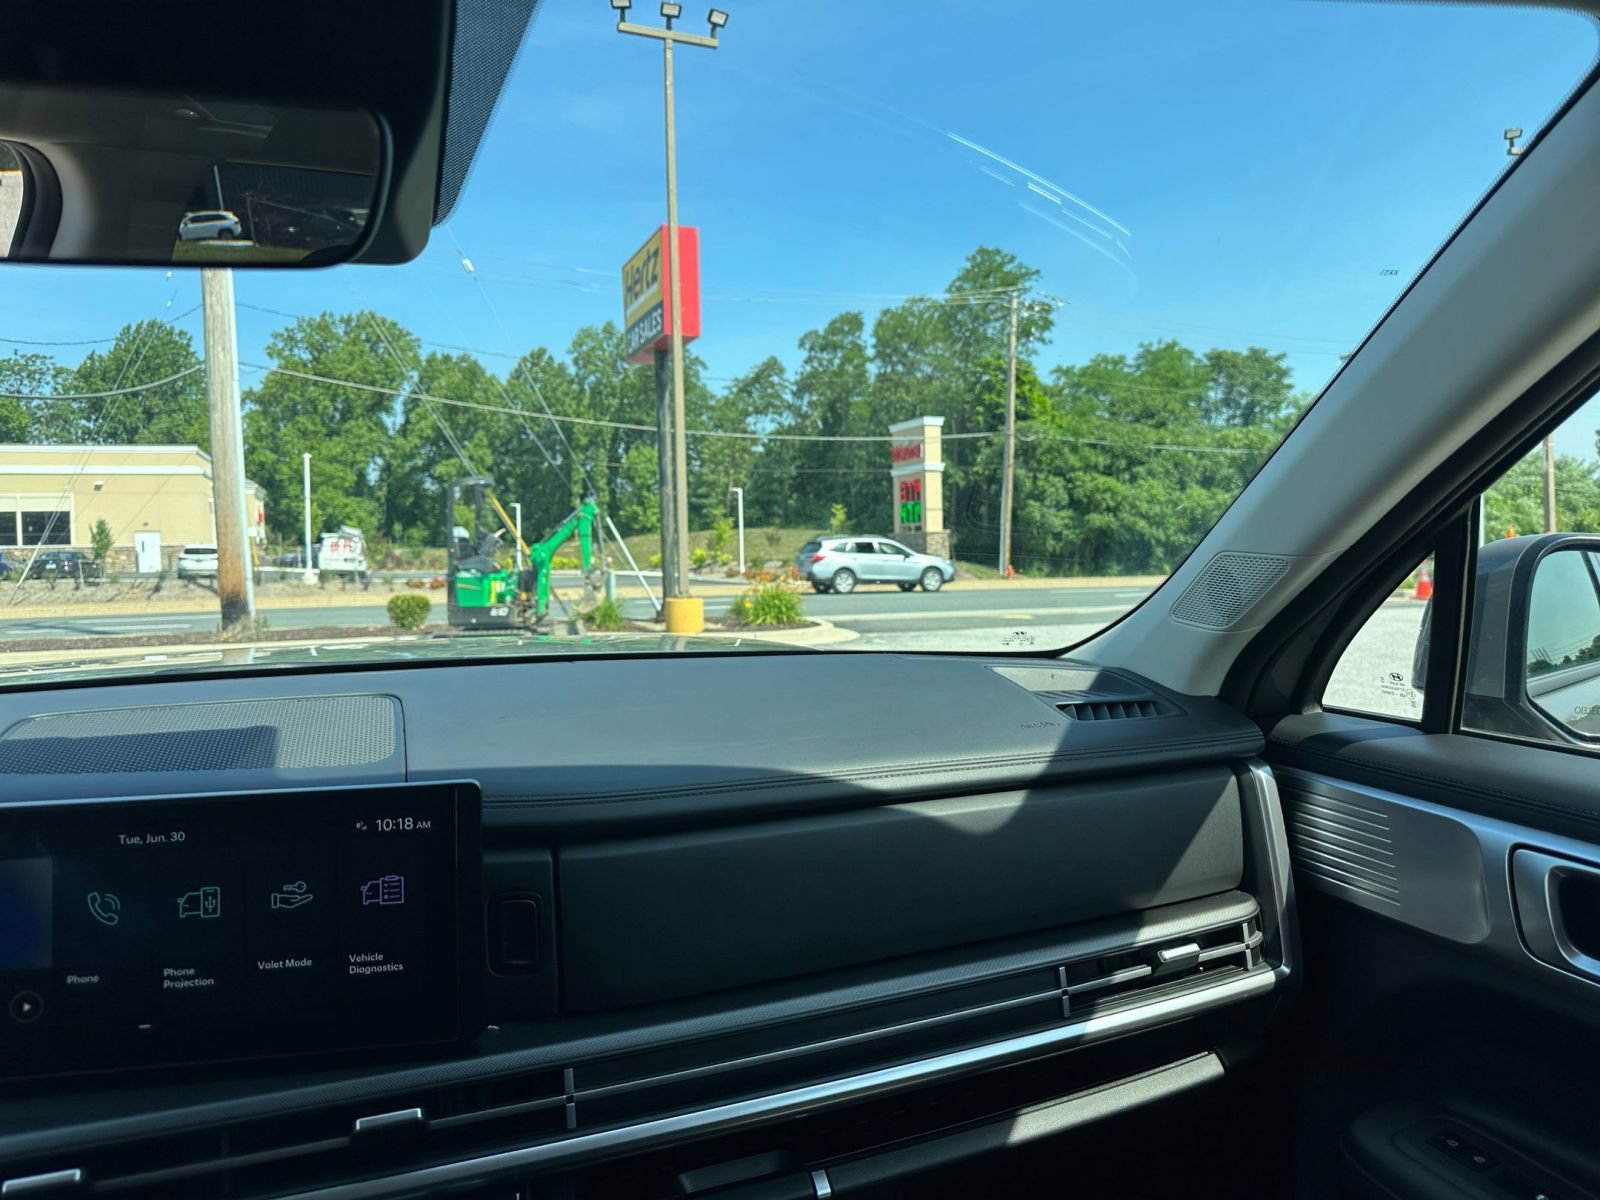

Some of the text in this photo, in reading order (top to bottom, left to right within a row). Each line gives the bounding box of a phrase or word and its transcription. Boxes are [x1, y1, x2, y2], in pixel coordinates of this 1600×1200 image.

[626, 248, 660, 304] Hertz
[640, 308, 662, 342] SALES
[375, 817, 431, 832] 10:18 AM
[118, 831, 186, 846] Tue, Jun. 30
[257, 957, 312, 971] Valet Mode
[348, 951, 384, 963] Vehicle
[163, 966, 195, 978] Phone
[348, 962, 404, 976] Diagnostics
[66, 973, 100, 985] Phone
[163, 977, 215, 990] Projection
